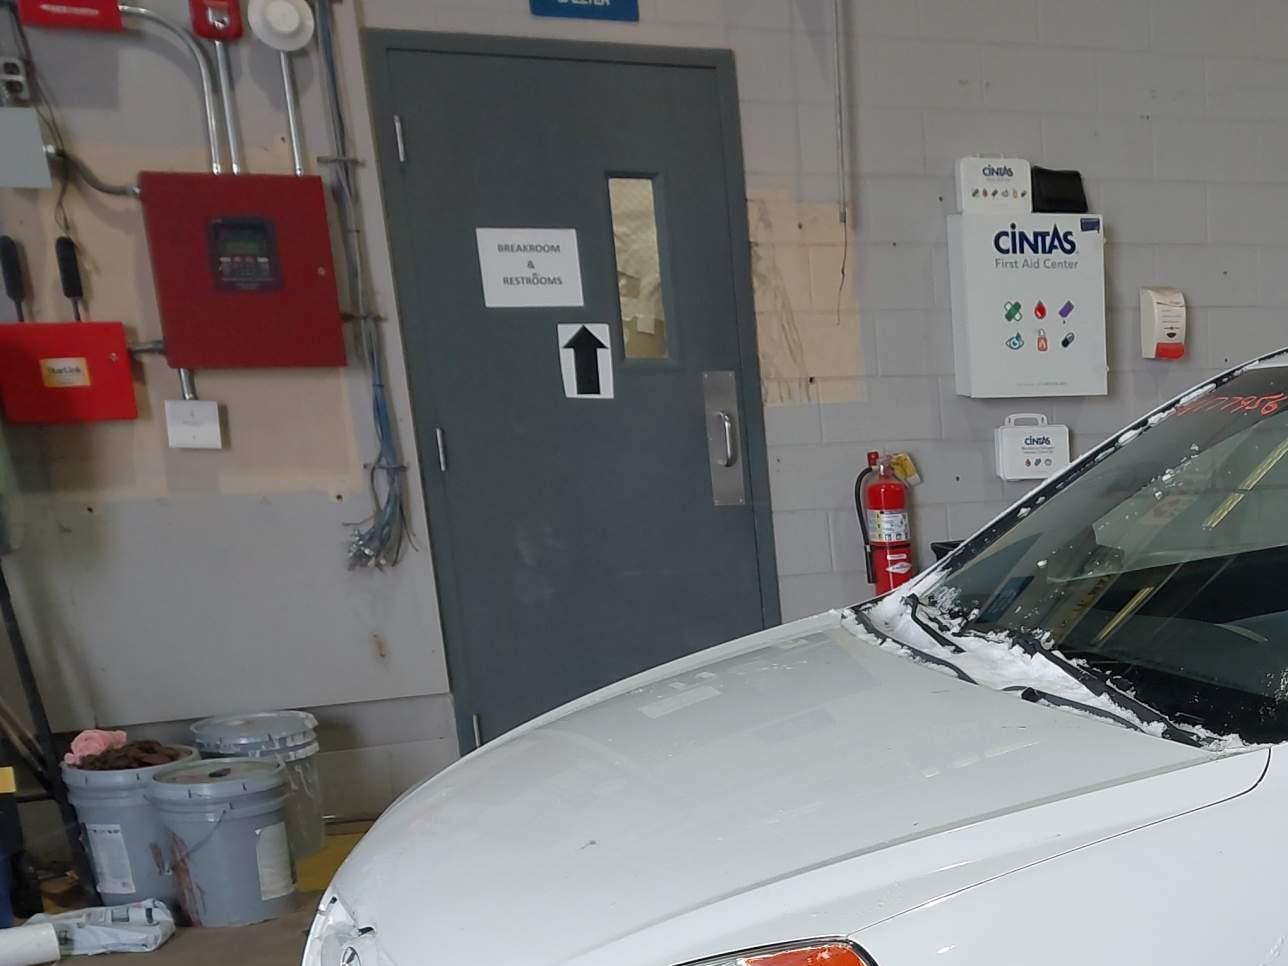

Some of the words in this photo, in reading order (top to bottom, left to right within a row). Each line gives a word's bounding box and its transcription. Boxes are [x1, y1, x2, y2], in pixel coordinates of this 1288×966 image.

[497, 243, 561, 254] BREAKROOM
[527, 260, 535, 269] &
[995, 259, 1019, 269] First
[1022, 259, 1040, 269] Aid
[1043, 259, 1079, 270] Center
[503, 275, 563, 286] RESTROOMS
